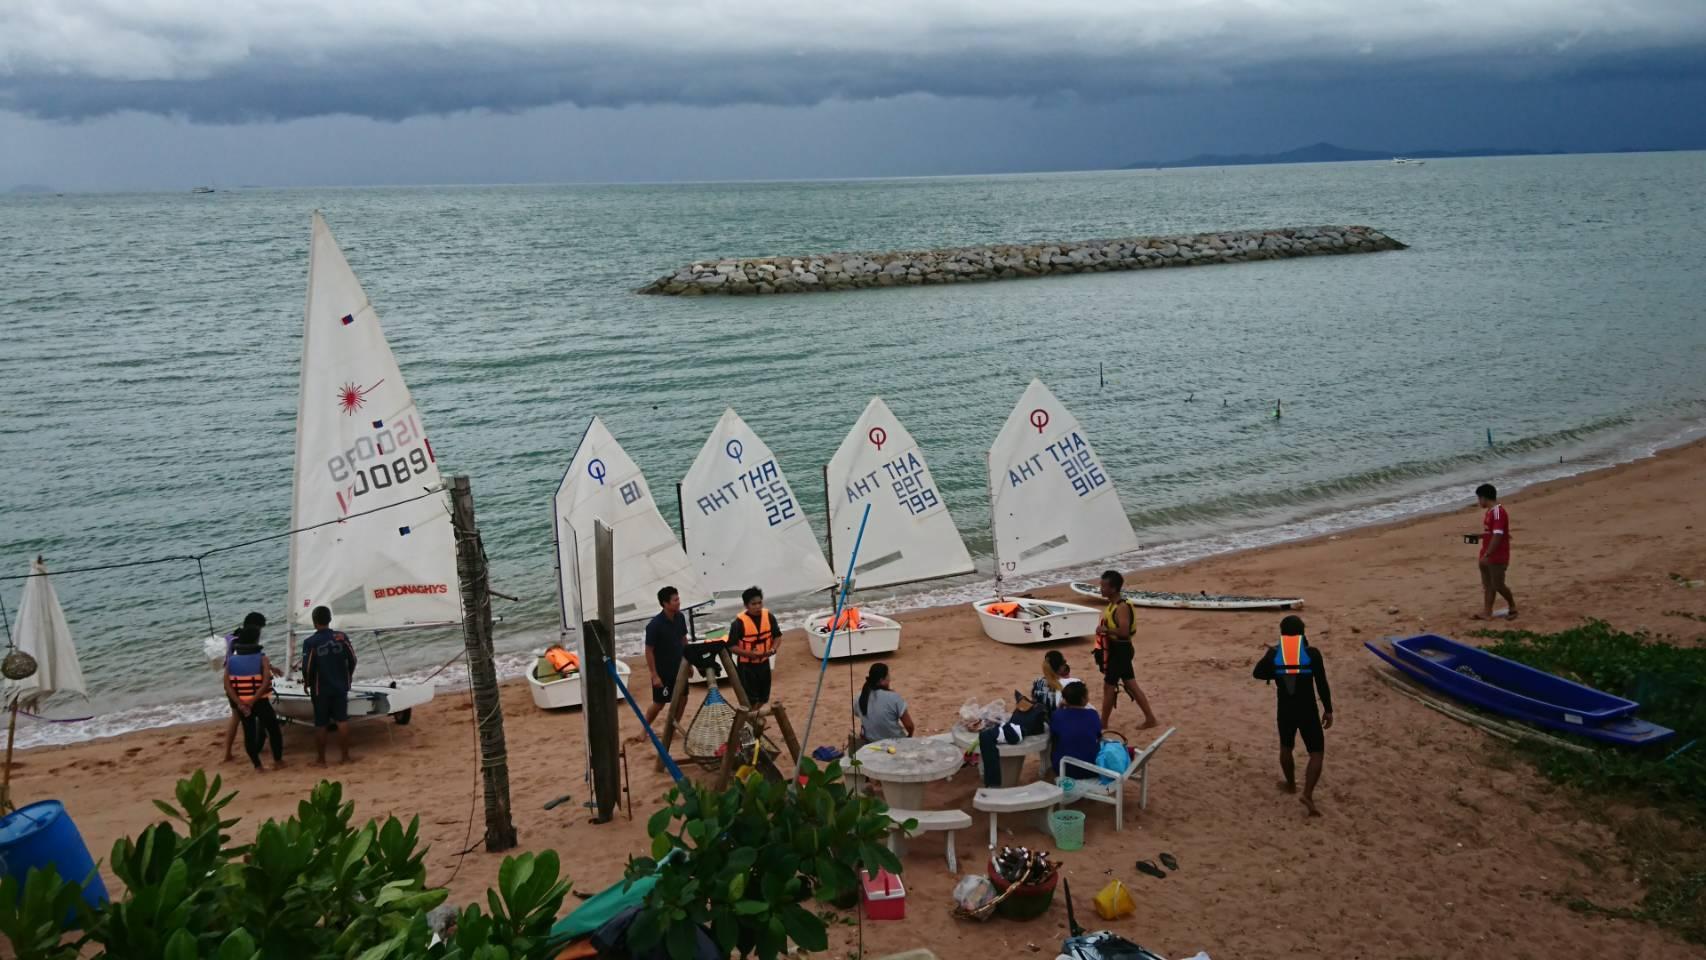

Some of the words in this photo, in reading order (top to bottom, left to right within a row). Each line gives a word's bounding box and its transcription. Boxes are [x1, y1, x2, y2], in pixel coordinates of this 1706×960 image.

[1045, 432, 1086, 462] THA
[739, 460, 778, 493] THA
[882, 452, 922, 480] THA
[1071, 467, 1107, 497] 916
[766, 498, 796, 527] 22
[899, 488, 938, 516] 799
[386, 583, 448, 597] DONAGHYS
